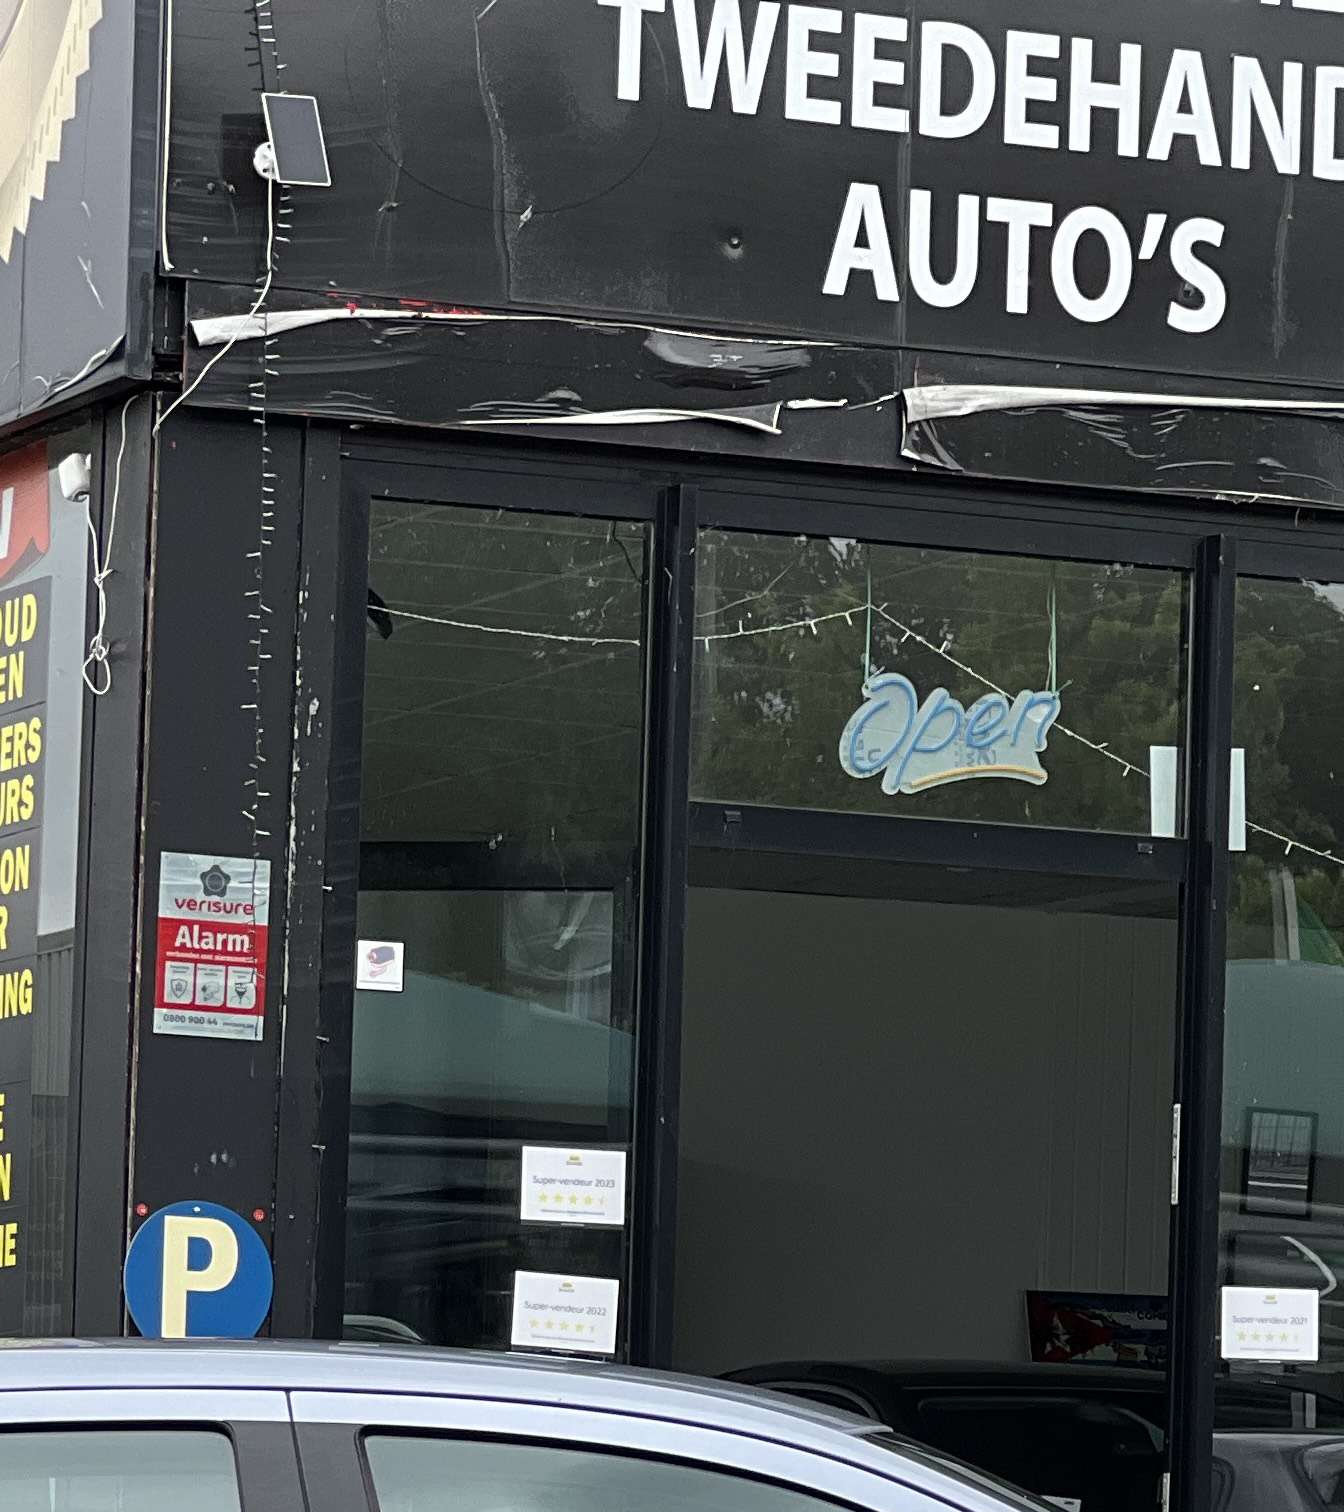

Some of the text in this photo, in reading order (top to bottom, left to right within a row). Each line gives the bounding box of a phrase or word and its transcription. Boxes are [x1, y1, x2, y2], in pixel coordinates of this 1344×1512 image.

[821, 181, 1228, 335] AUTO'S
[849, 679, 1057, 790] Open
[174, 897, 254, 916] verisure
[174, 924, 252, 953] Alarm
[161, 1215, 239, 1339] P
